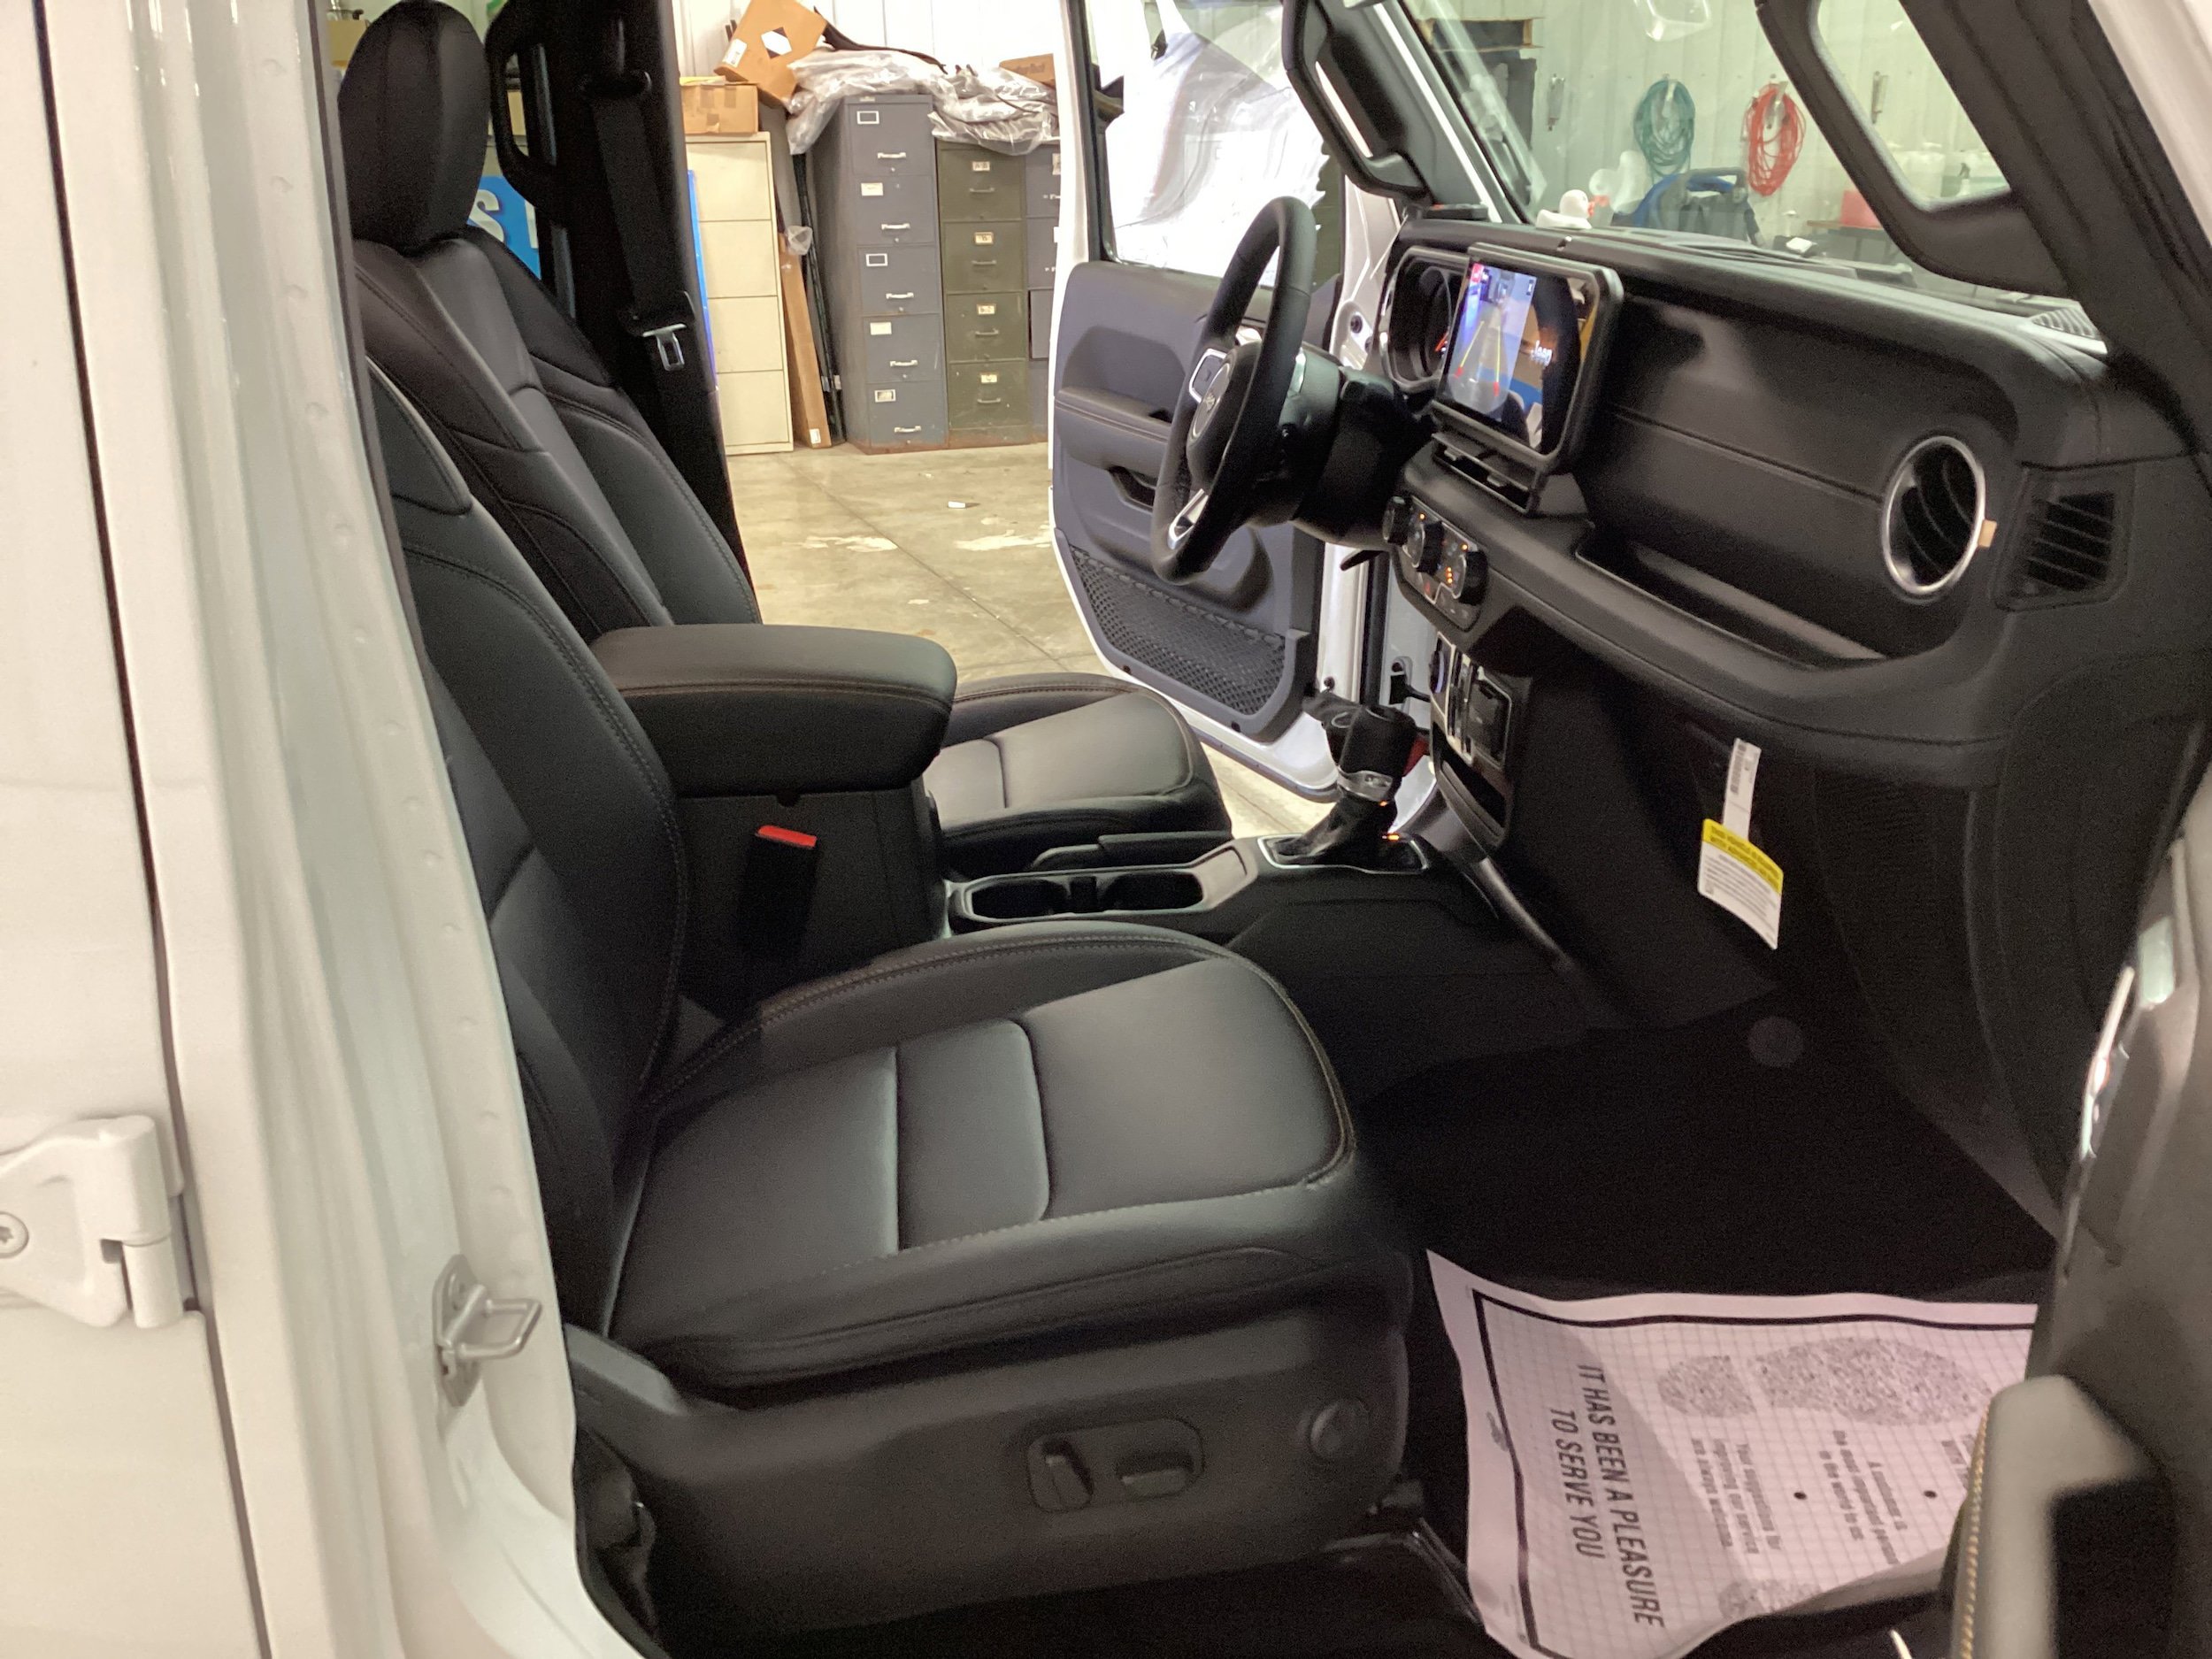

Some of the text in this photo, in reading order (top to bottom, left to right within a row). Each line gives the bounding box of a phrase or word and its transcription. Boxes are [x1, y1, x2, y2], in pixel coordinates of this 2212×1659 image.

[1550, 1408, 1606, 1560] TO SERVE YOU
[1578, 1364, 1665, 1629] IT HAS BEEN A PLEASURE
